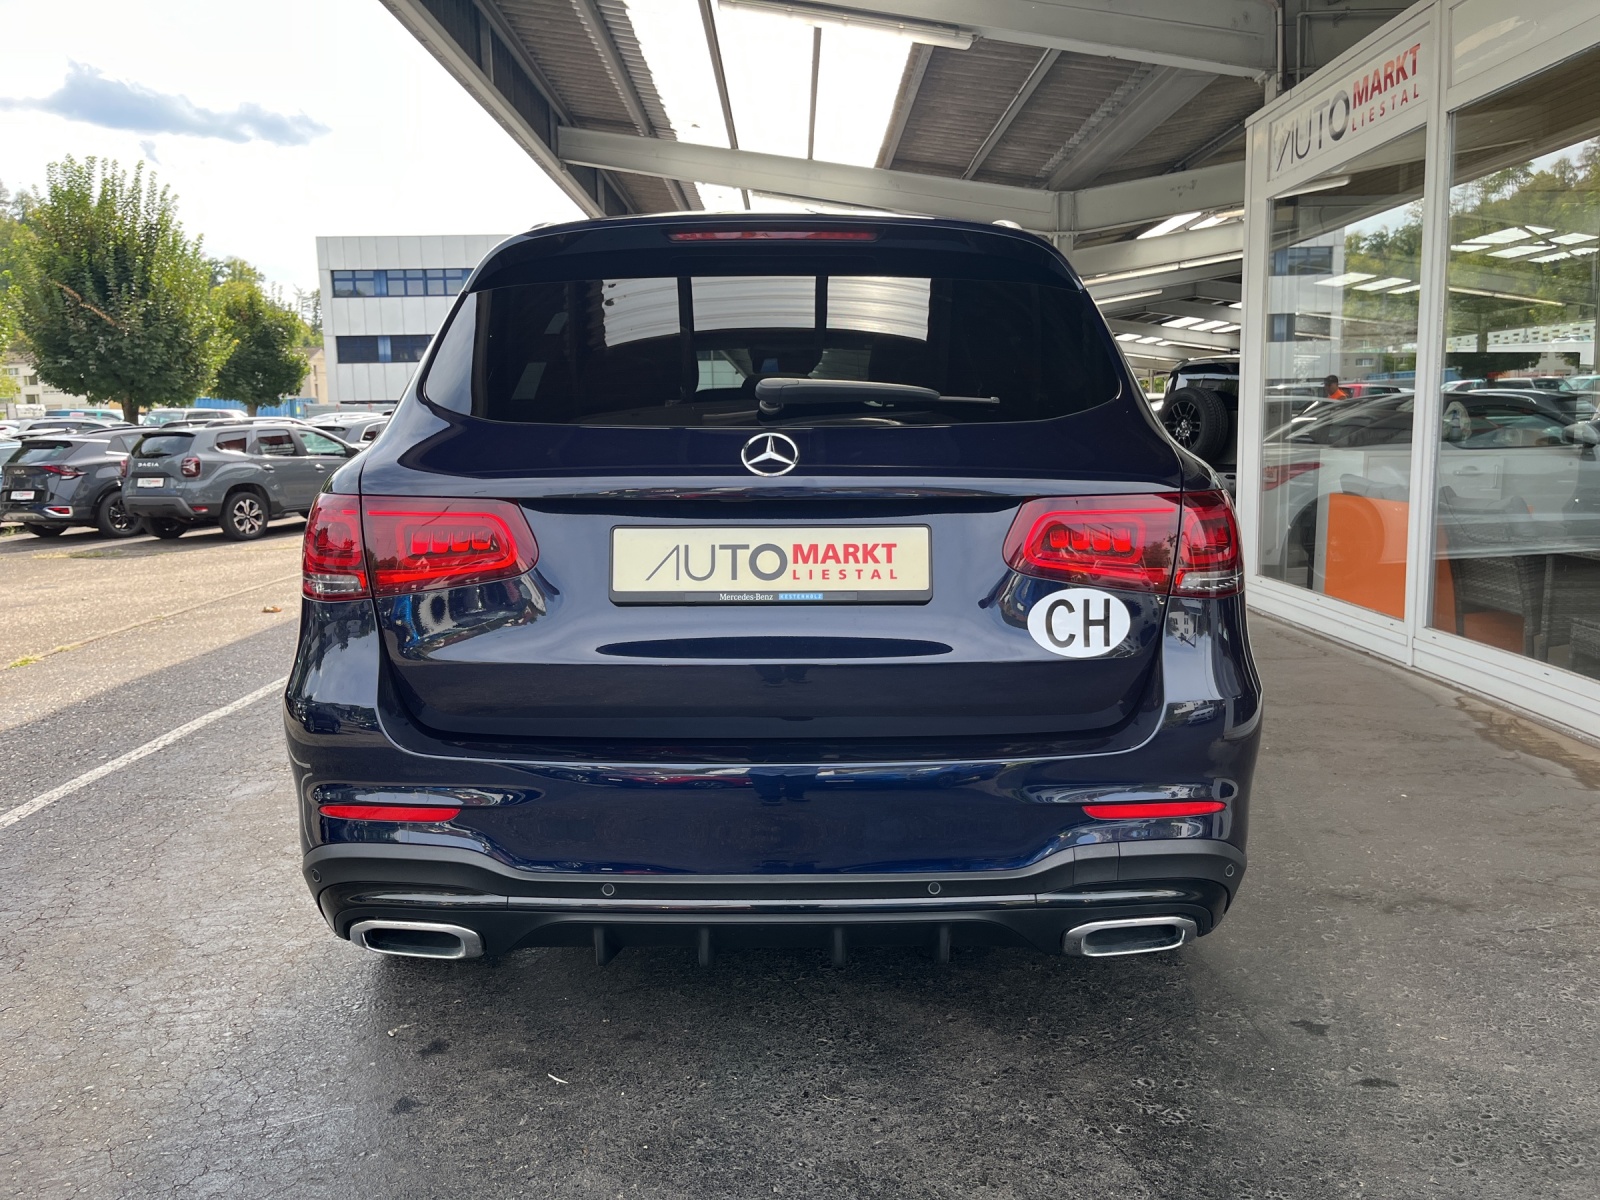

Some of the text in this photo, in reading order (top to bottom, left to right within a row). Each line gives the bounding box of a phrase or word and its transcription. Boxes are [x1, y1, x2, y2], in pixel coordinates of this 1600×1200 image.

[1352, 42, 1421, 110] MARKT
[1352, 83, 1419, 132] LIESTAL
[645, 543, 897, 581] AUTO MARKT
[792, 569, 898, 580] LIESTAL
[719, 593, 773, 601] Mercedes-Benz
[1045, 598, 1111, 648] CH
